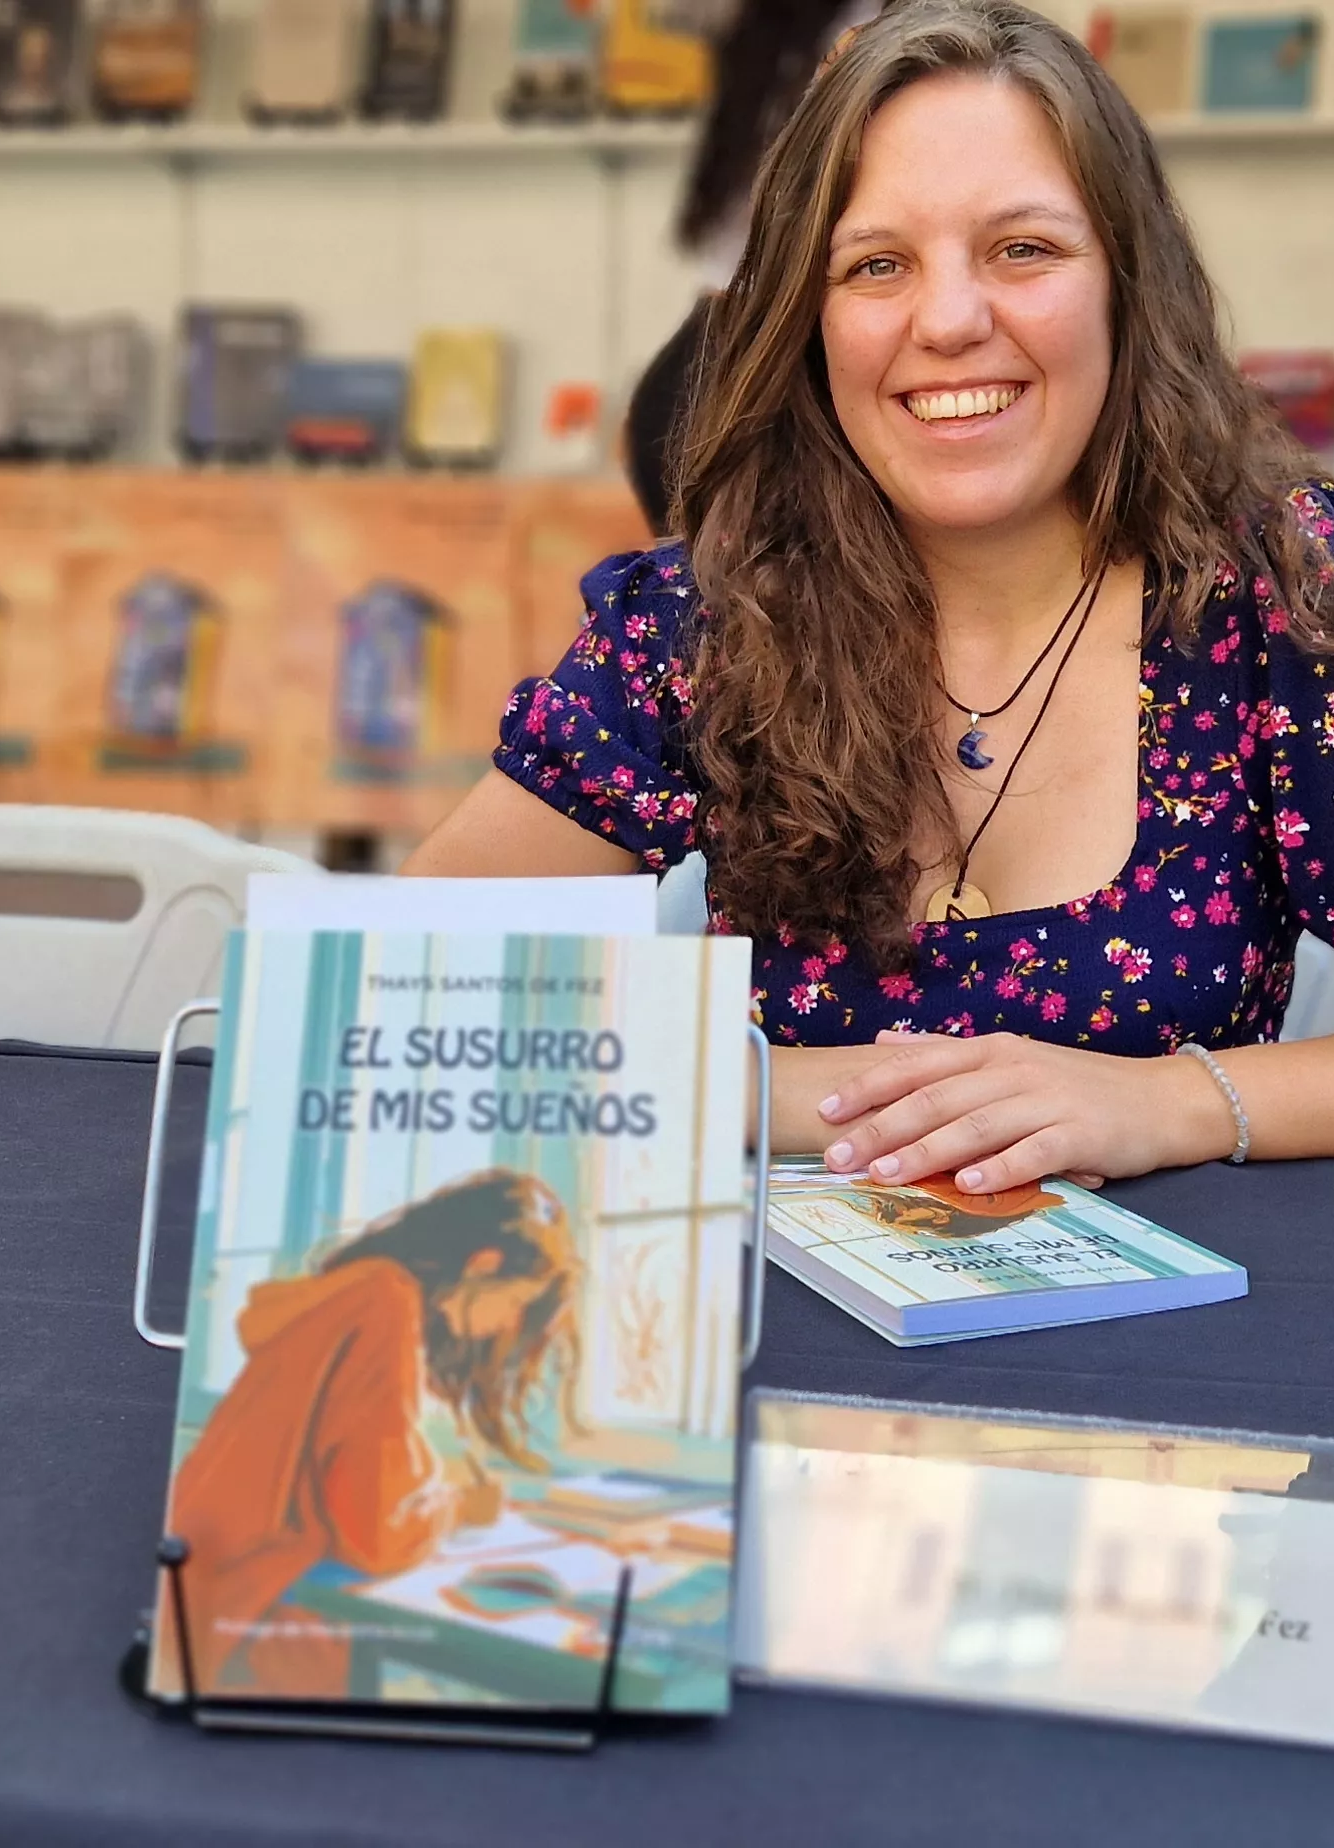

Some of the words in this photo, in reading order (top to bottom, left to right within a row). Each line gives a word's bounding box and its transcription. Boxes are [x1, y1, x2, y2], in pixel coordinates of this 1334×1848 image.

[367, 975, 433, 992] THAYS
[439, 976, 525, 993] SANTOS
[530, 977, 557, 993] DE
[564, 977, 605, 994] FEZ
[338, 1026, 391, 1069] EL
[403, 1027, 624, 1073] SUSURRO
[298, 1089, 358, 1131] DE
[369, 1089, 455, 1133] MIS
[467, 1080, 657, 1137] SUEÑOS
[1014, 1238, 1076, 1251] MIS
[1075, 1234, 1120, 1246] DE
[933, 1252, 1080, 1273] SUSURRO
[1080, 1249, 1122, 1260] EL
[1257, 1608, 1311, 1641] Fez
